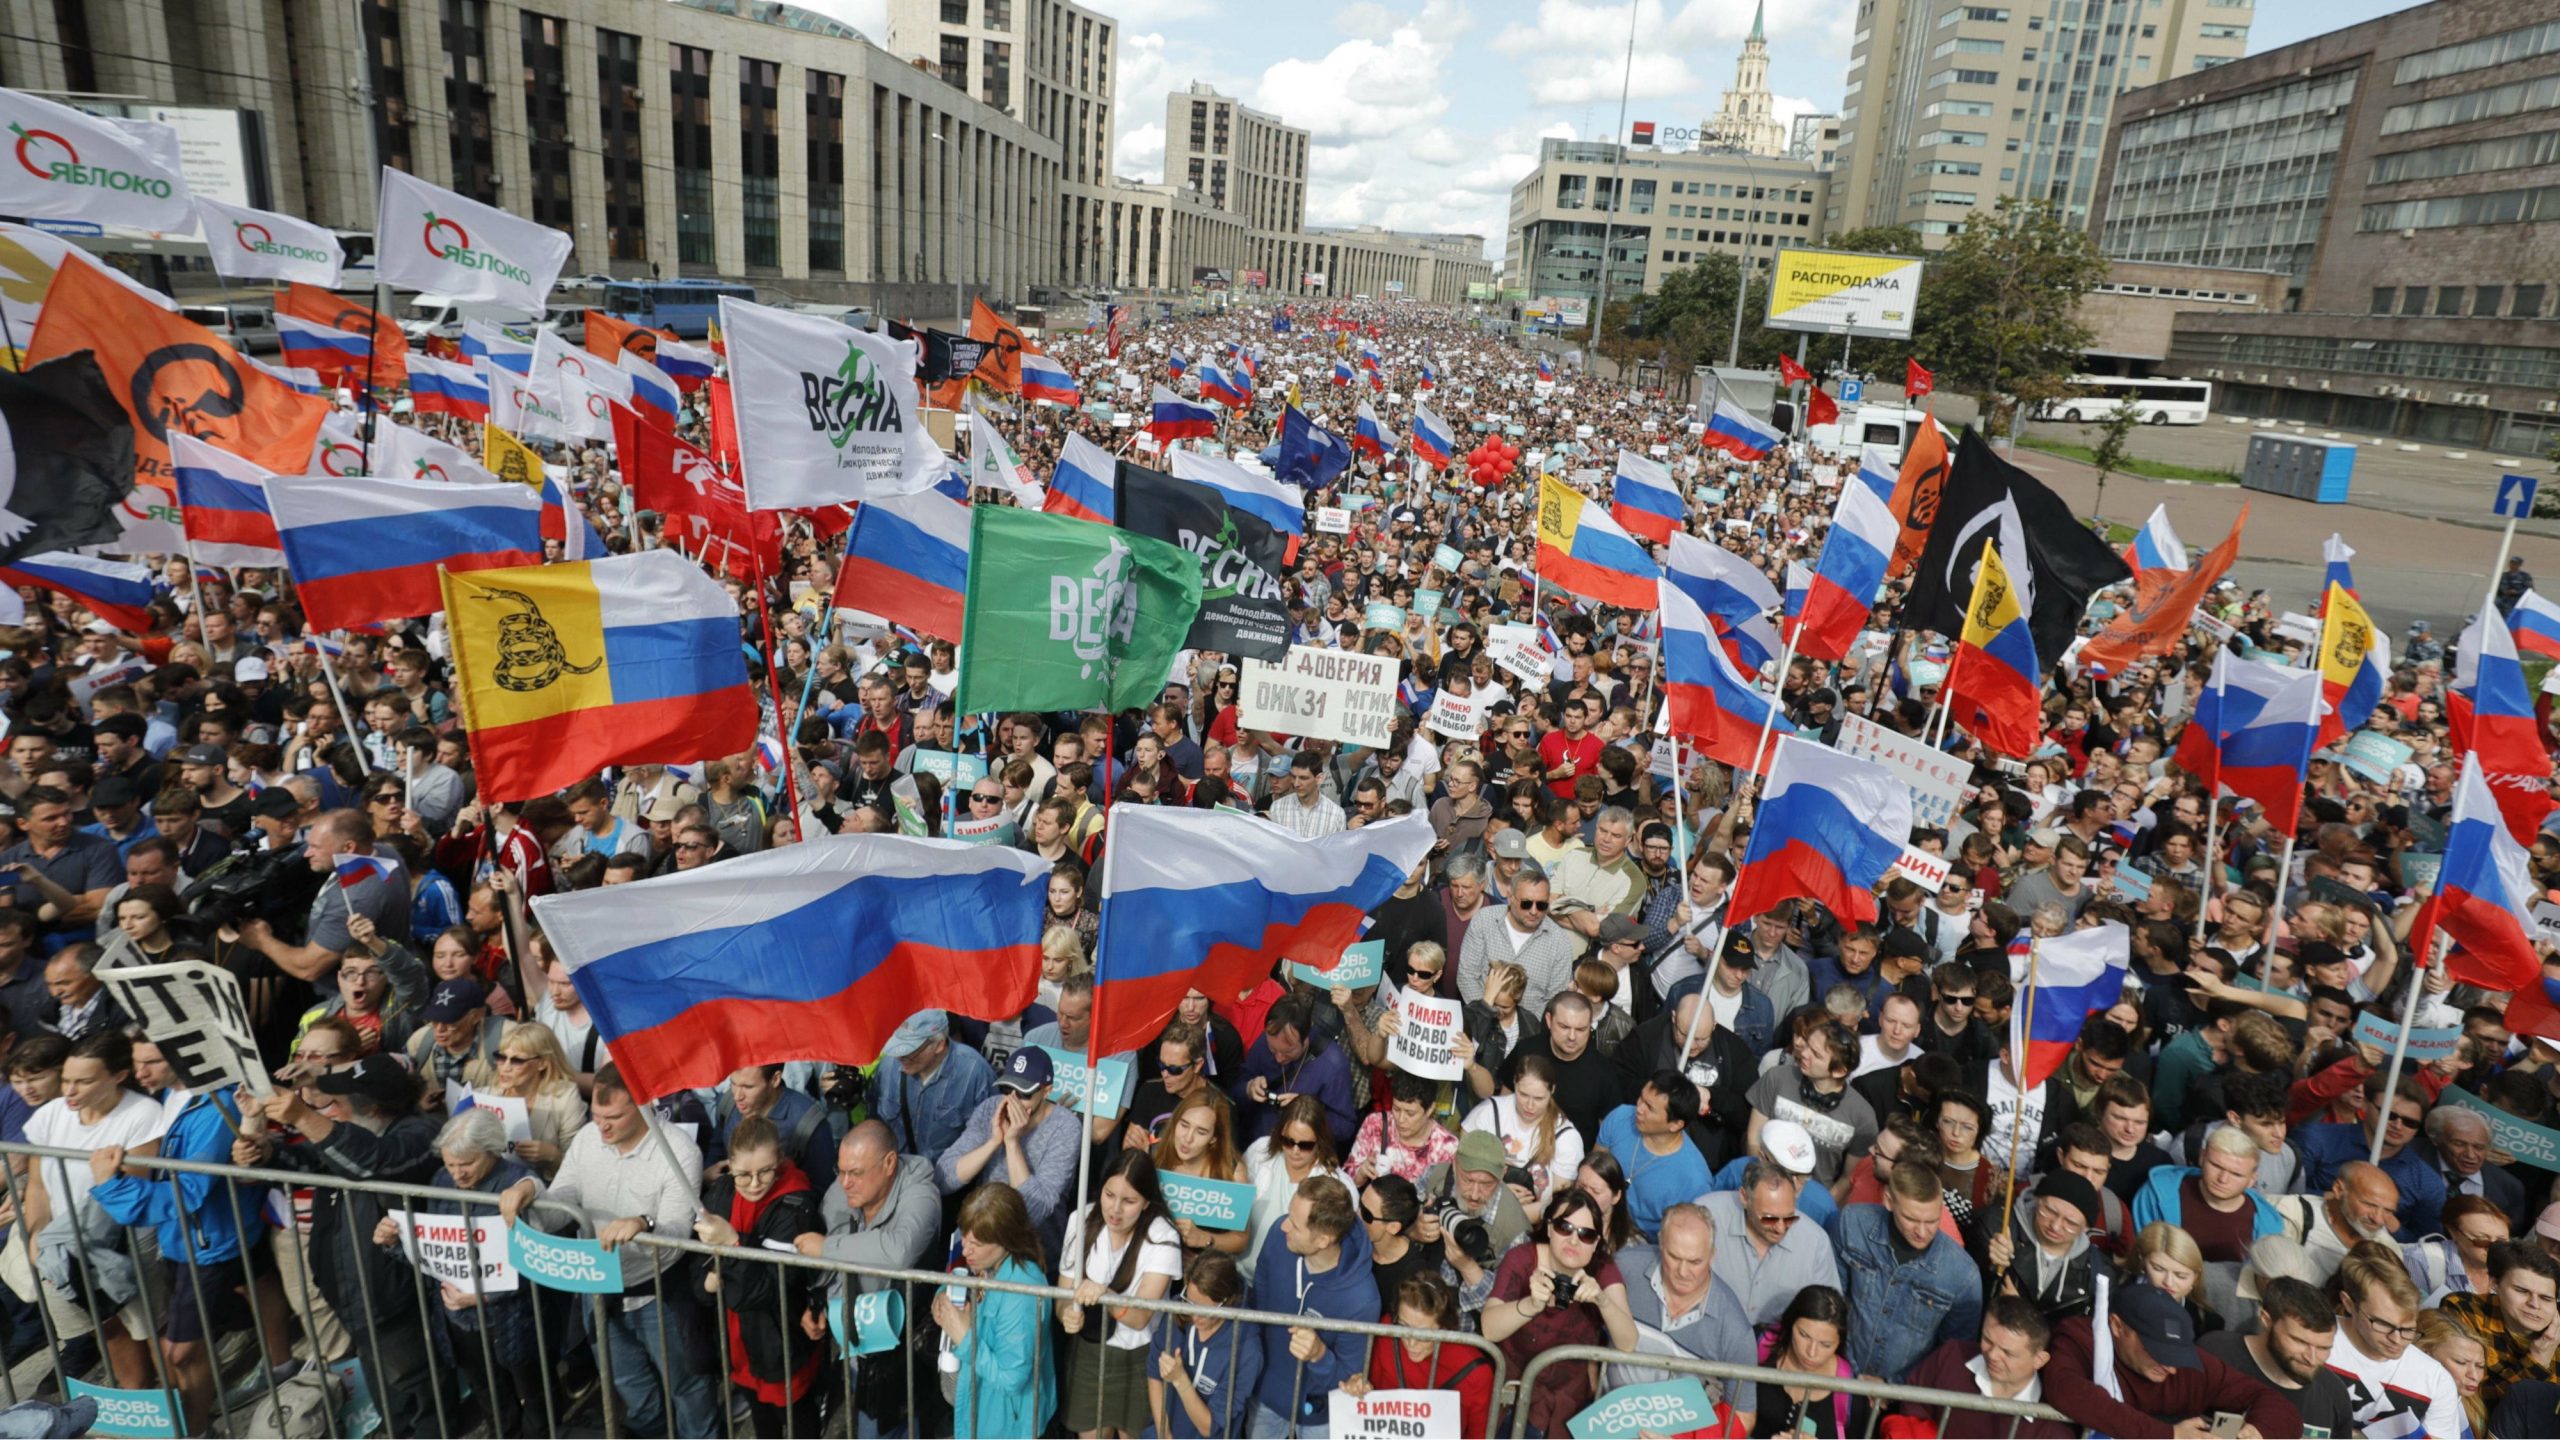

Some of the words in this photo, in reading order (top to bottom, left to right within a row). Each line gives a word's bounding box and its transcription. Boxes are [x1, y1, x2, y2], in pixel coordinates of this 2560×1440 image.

[1664, 127, 1745, 144] РОСАНК
[48, 161, 172, 199] ЯБЛОКО
[252, 240, 328, 264] ЯБЛОКО
[442, 244, 531, 286] ЯБЛОКО
[1792, 271, 1899, 290] РАСПРОДАЖА
[1844, 383, 1857, 398] P
[800, 372, 902, 433] ВЕСНА
[1229, 604, 1284, 622] Молодёжно
[1236, 628, 1284, 645] движение
[1504, 655, 1515, 666] НА
[1516, 651, 1540, 669] ПРАВО
[1522, 644, 1547, 663] ИМЕЮ
[1297, 652, 1383, 686] ДОВЕРИЯ
[1256, 681, 1300, 714] ОИК
[1301, 689, 1328, 719] 31
[1345, 689, 1394, 714] МГИК
[1445, 700, 1472, 714] ИМЕЮ
[1342, 711, 1390, 739] ЦИК
[1433, 715, 1442, 725] НА
[1442, 718, 1475, 733] ВЫБОР!
[1440, 708, 1467, 723] ПРАВО
[922, 757, 973, 772] ЛЮБВЬ
[930, 768, 976, 783] ОБЛЬ
[1408, 1002, 1415, 1017] Я
[1415, 1002, 1452, 1027] ИМЕЮ
[1407, 1021, 1447, 1045] ПРАВО
[1396, 1036, 1408, 1056] НА
[1409, 1043, 1457, 1066] ВЫБОР!
[2494, 1132, 2558, 1162] БОЛЬ
[1160, 1183, 1233, 1206] ЮБОВЬ
[1168, 1198, 1236, 1220] ОБОЛЬ
[414, 1225, 425, 1238] Я
[514, 1230, 596, 1266] ЛЮБОВЬ
[523, 1252, 606, 1281] СОБОЛЬ
[97, 1410, 170, 1429] ОБОЛЬ
[1356, 1400, 1369, 1416] Я
[1372, 1400, 1432, 1419] ИМЕЮ
[1588, 1394, 1684, 1433] ЛЮБОВЬ
[1364, 1418, 1426, 1438] ПРАВО
[1605, 1408, 1698, 1434] СОБОЛЬ
